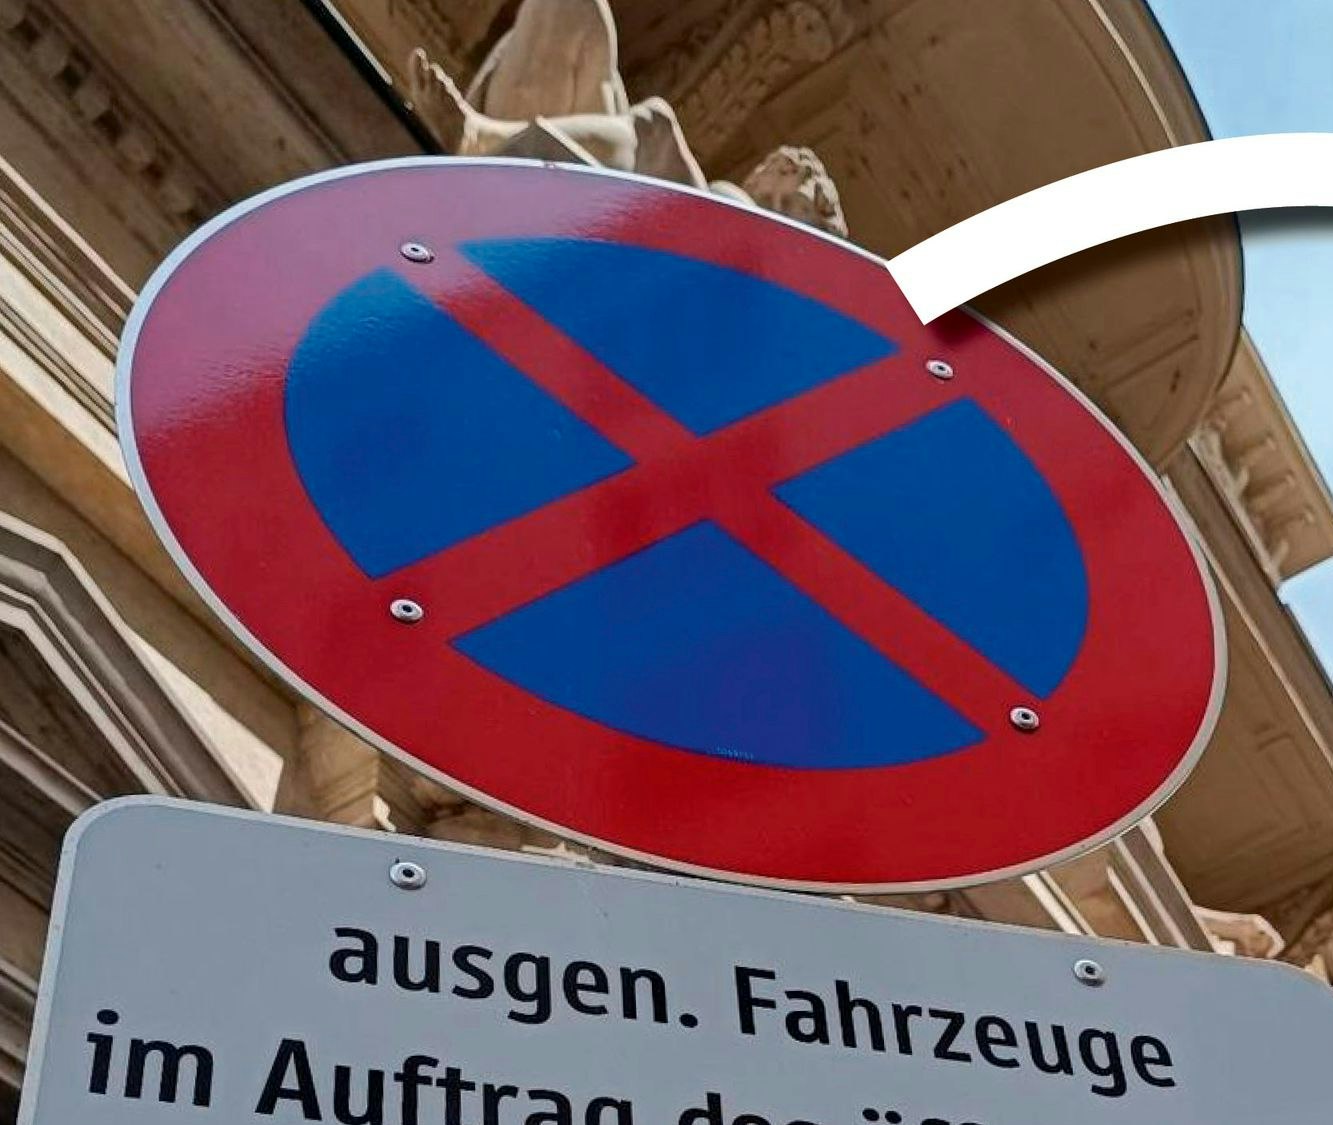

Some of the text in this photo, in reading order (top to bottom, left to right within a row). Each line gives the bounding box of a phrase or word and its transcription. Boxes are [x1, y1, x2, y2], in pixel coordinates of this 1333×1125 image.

[85, 1009, 214, 1108] im
[328, 925, 1177, 1099] ausgen. Fahrzeuge
